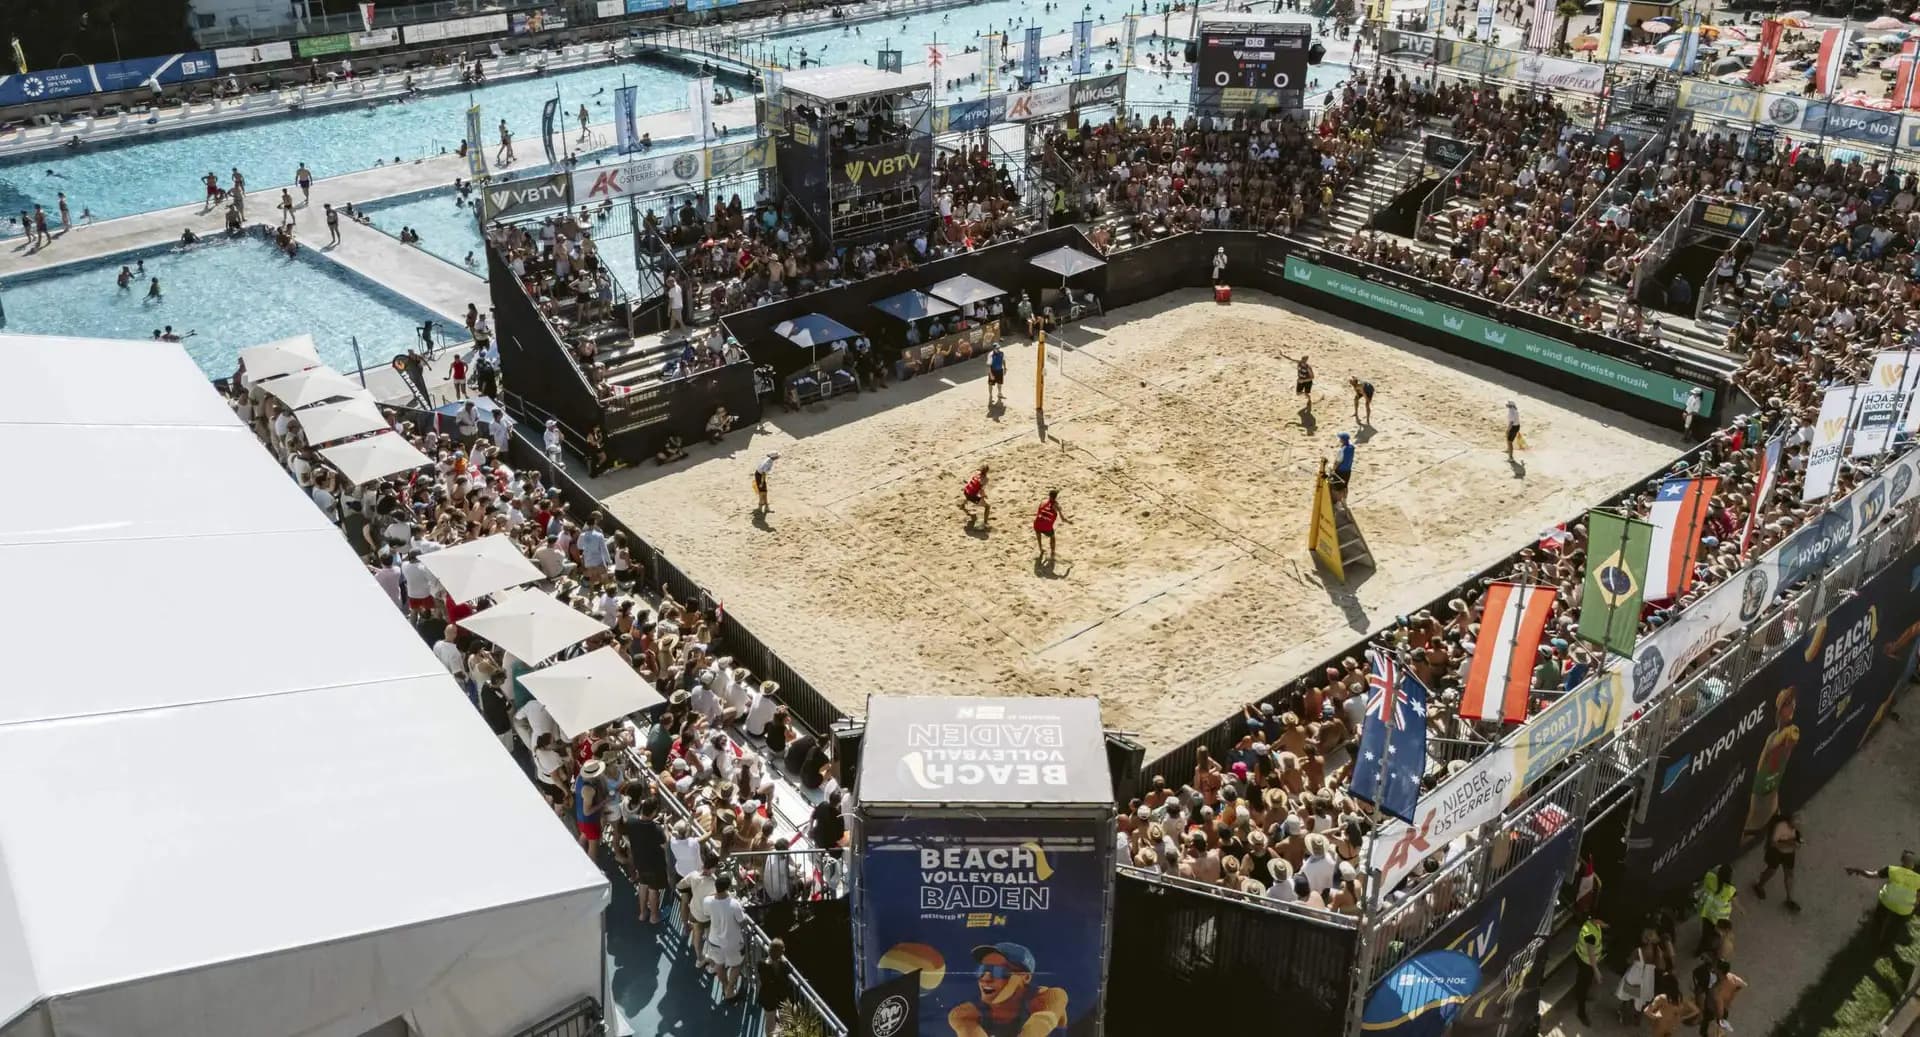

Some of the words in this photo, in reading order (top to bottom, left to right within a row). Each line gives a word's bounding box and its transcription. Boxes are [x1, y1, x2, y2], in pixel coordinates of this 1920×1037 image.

[46, 73, 67, 81] GREAT
[1214, 71, 1230, 86] 0
[1273, 72, 1289, 88] 0
[964, 108, 989, 121] HYPO
[990, 105, 1005, 117] NOE
[1830, 115, 1866, 130] HYPO
[1870, 122, 1898, 137] NOE
[868, 152, 920, 178] VBTV
[511, 182, 568, 206] VBTV
[589, 168, 623, 199] AK
[1326, 279, 1340, 289] wir
[1340, 281, 1357, 294] sind
[1357, 286, 1370, 299] die
[1370, 293, 1399, 309] meiste
[1400, 302, 1425, 317] musik
[1525, 342, 1542, 353] wir
[1542, 345, 1563, 362] sind
[1563, 352, 1579, 368] die
[1580, 360, 1615, 380] meiste
[1616, 371, 1649, 390] musik
[1798, 537, 1831, 568] HYPO
[1831, 519, 1850, 548] NOE
[1823, 613, 1873, 669] BEACH
[1822, 635, 1872, 684] VOLLEYBALL
[1818, 645, 1875, 716] BADEN
[907, 723, 1064, 748] BADEN
[1534, 708, 1574, 749] SPORT
[1691, 728, 1736, 776] HYPO
[1736, 700, 1767, 740] NOE
[921, 749, 1066, 762] VOLLEYBALL
[926, 763, 1070, 786] BEACH
[1434, 771, 1512, 836] ÖSTERREICH
[1442, 769, 1490, 815] NIEDER
[1651, 767, 1747, 875] WILLKOMMEN
[920, 846, 1035, 870] BEACH
[1380, 806, 1438, 888] AK
[920, 870, 1039, 885] VOLLEYBALL
[920, 884, 1050, 911] BADEN
[920, 913, 956, 921] PRESENTED
[1446, 976, 1469, 985] NOE
